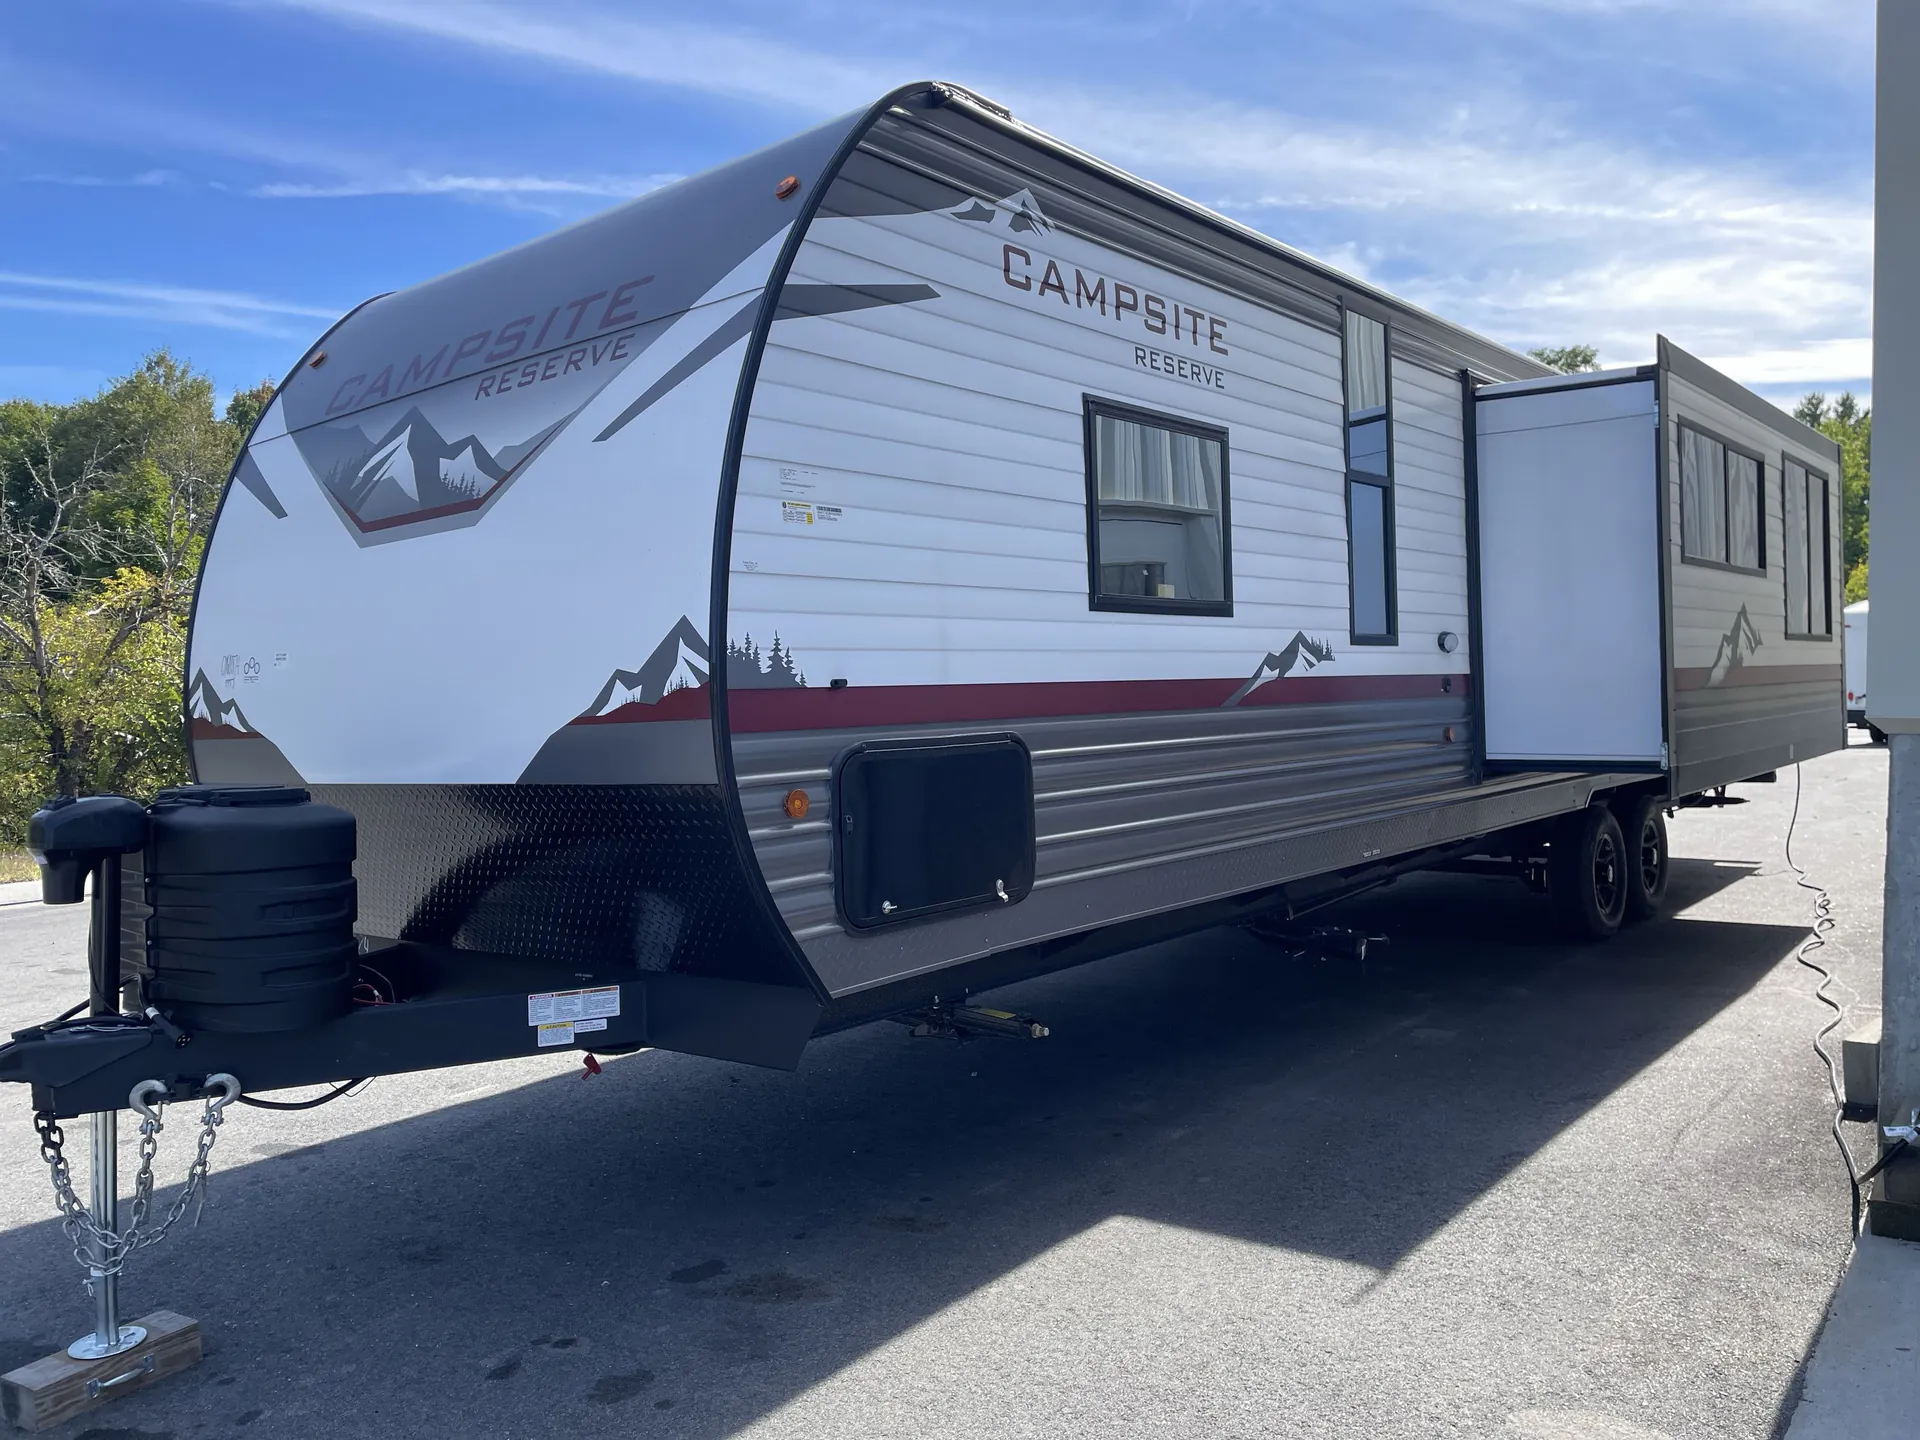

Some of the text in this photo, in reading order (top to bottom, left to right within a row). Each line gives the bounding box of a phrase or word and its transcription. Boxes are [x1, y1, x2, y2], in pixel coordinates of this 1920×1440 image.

[324, 274, 656, 416] CAMPSITE
[1003, 243, 1229, 356] CAMPSITE
[475, 332, 636, 401] RESERVE
[1134, 346, 1225, 389] RESERVE
